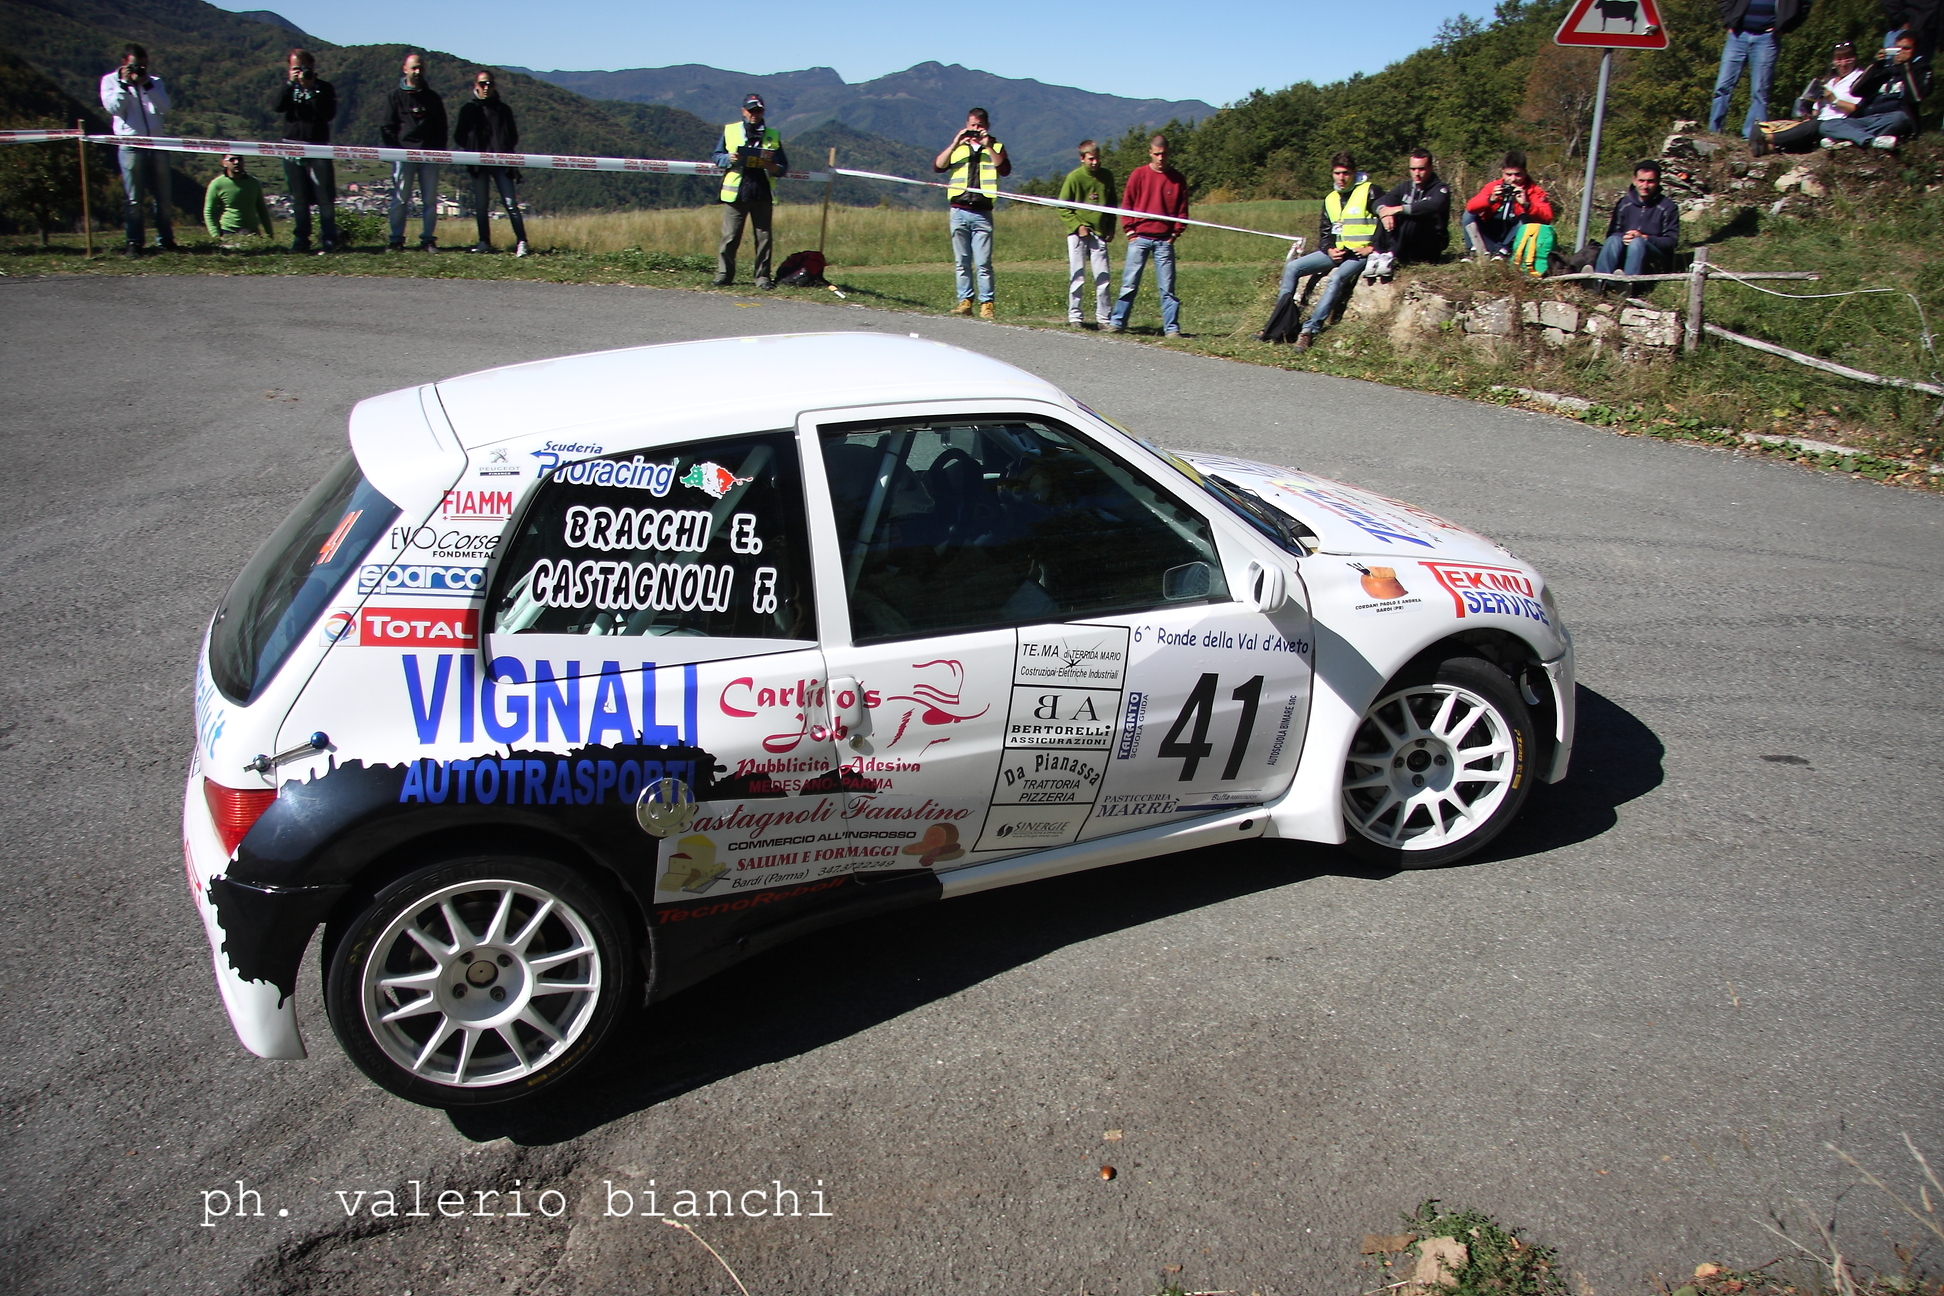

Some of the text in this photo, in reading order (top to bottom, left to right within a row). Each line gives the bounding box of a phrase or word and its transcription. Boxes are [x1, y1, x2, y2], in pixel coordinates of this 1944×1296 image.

[543, 441, 603, 455] Scuderia
[533, 451, 675, 496] Proracing
[442, 490, 512, 514] FIAMM
[566, 507, 762, 554] BRACCHI E.
[433, 551, 497, 559] FONDMETAL
[360, 566, 487, 594] sparco
[531, 560, 777, 613] CASTAGNOLI F.
[1417, 561, 1534, 618] TEKMU
[1462, 591, 1550, 626] SERVICE
[366, 616, 474, 640] TOTAL
[1158, 627, 1197, 647] Ronde
[1203, 631, 1233, 650] della
[1238, 633, 1257, 651] Val
[1263, 634, 1309, 654] d'Aveto
[1022, 643, 1059, 658] TE.MA
[1099, 651, 1121, 661] MARIO
[1058, 667, 1087, 678] Elettriche
[1088, 668, 1119, 680] Industriali
[402, 654, 698, 748] VIGNALI
[1118, 693, 1140, 758] TARANTO
[1130, 694, 1149, 759] SCUOLA GUIDA
[1157, 672, 1265, 781] 41
[1010, 737, 1107, 745] ASSICURAZIONI
[1266, 730, 1287, 766] AUTOSCUOLA
[734, 756, 921, 781] Pubblicità Adesiva
[1004, 753, 1101, 786] Da Pianassa
[400, 759, 696, 805] AUTOTRASPORTI
[841, 777, 893, 791] PARMA
[1022, 779, 1080, 790] TRATTORIA
[841, 795, 976, 821] Faustino
[1018, 792, 1076, 802] PIZZERIA
[1104, 793, 1171, 803] PASTICCERIA
[1014, 822, 1070, 831] SINERGIE
[727, 830, 918, 851] COMMERCIO ALL'INGROSSO
[736, 845, 900, 872] SALUMI E FORMAGGI
[731, 874, 762, 889] Bardi
[764, 868, 810, 886] (Parma)
